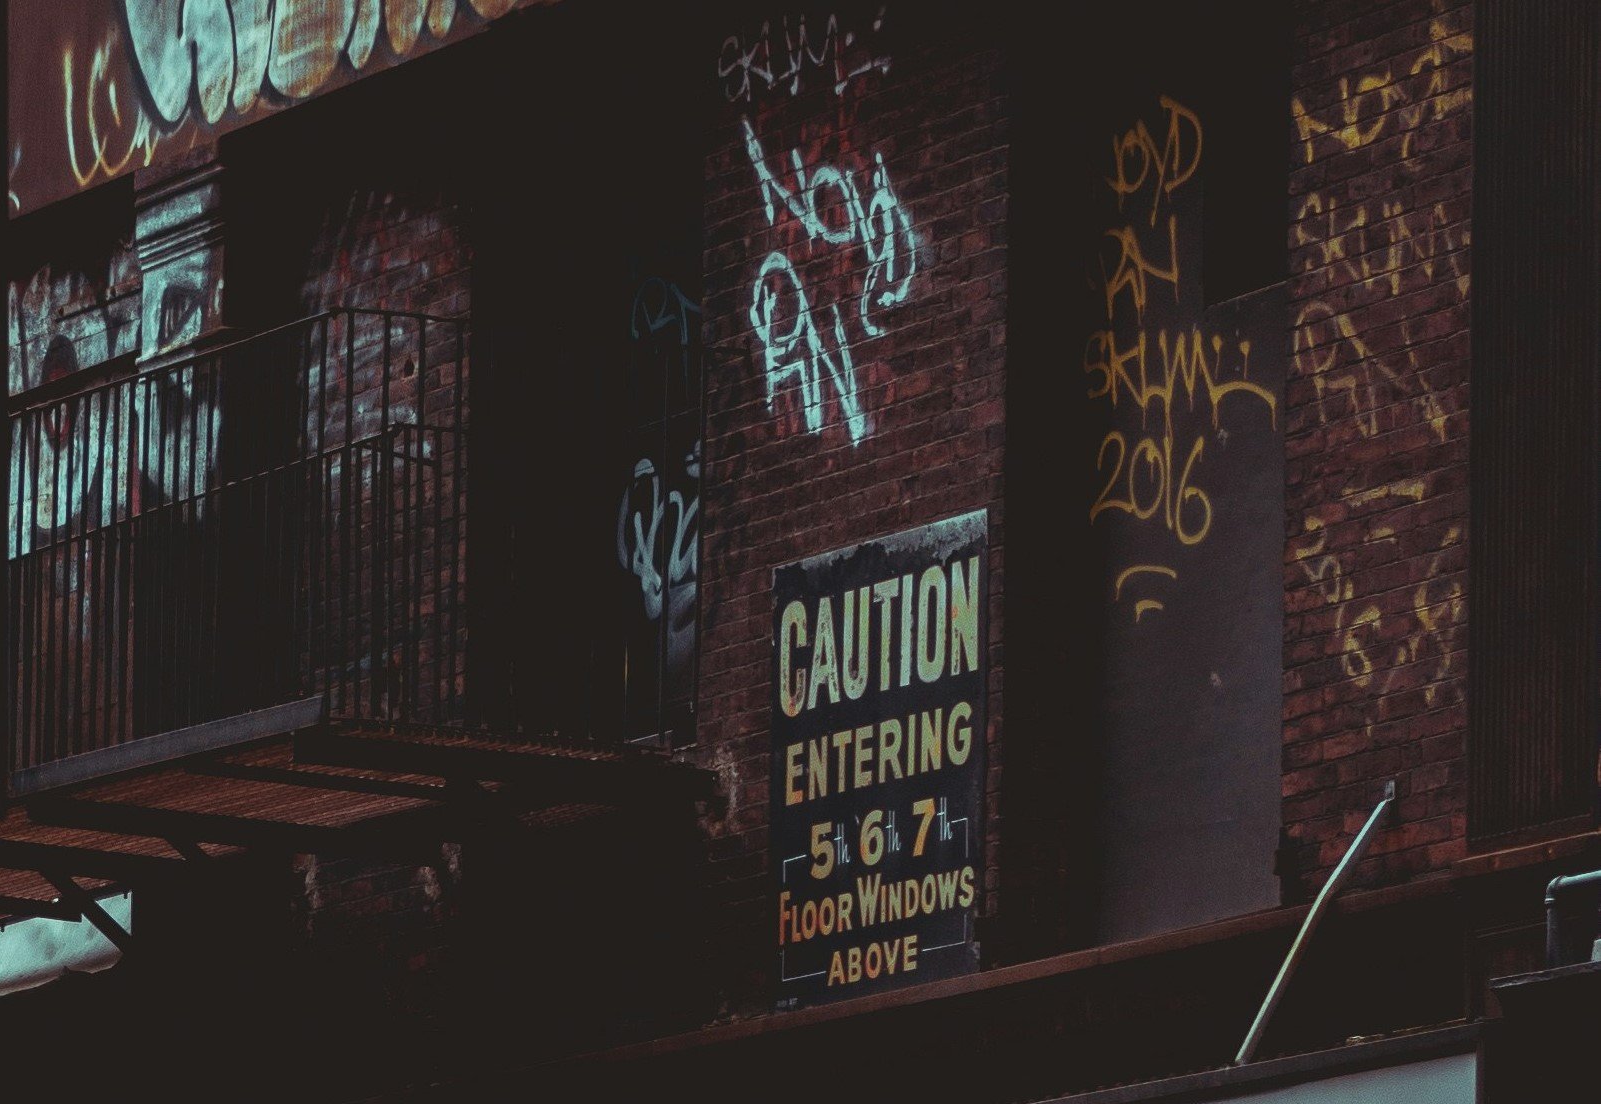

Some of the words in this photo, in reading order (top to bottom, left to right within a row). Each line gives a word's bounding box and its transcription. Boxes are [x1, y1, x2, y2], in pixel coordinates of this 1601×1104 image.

[1088, 429, 1213, 546] 2016
[779, 555, 980, 718] CAUTION
[785, 701, 973, 806] ENTERING
[827, 934, 918, 988] ABOVE
